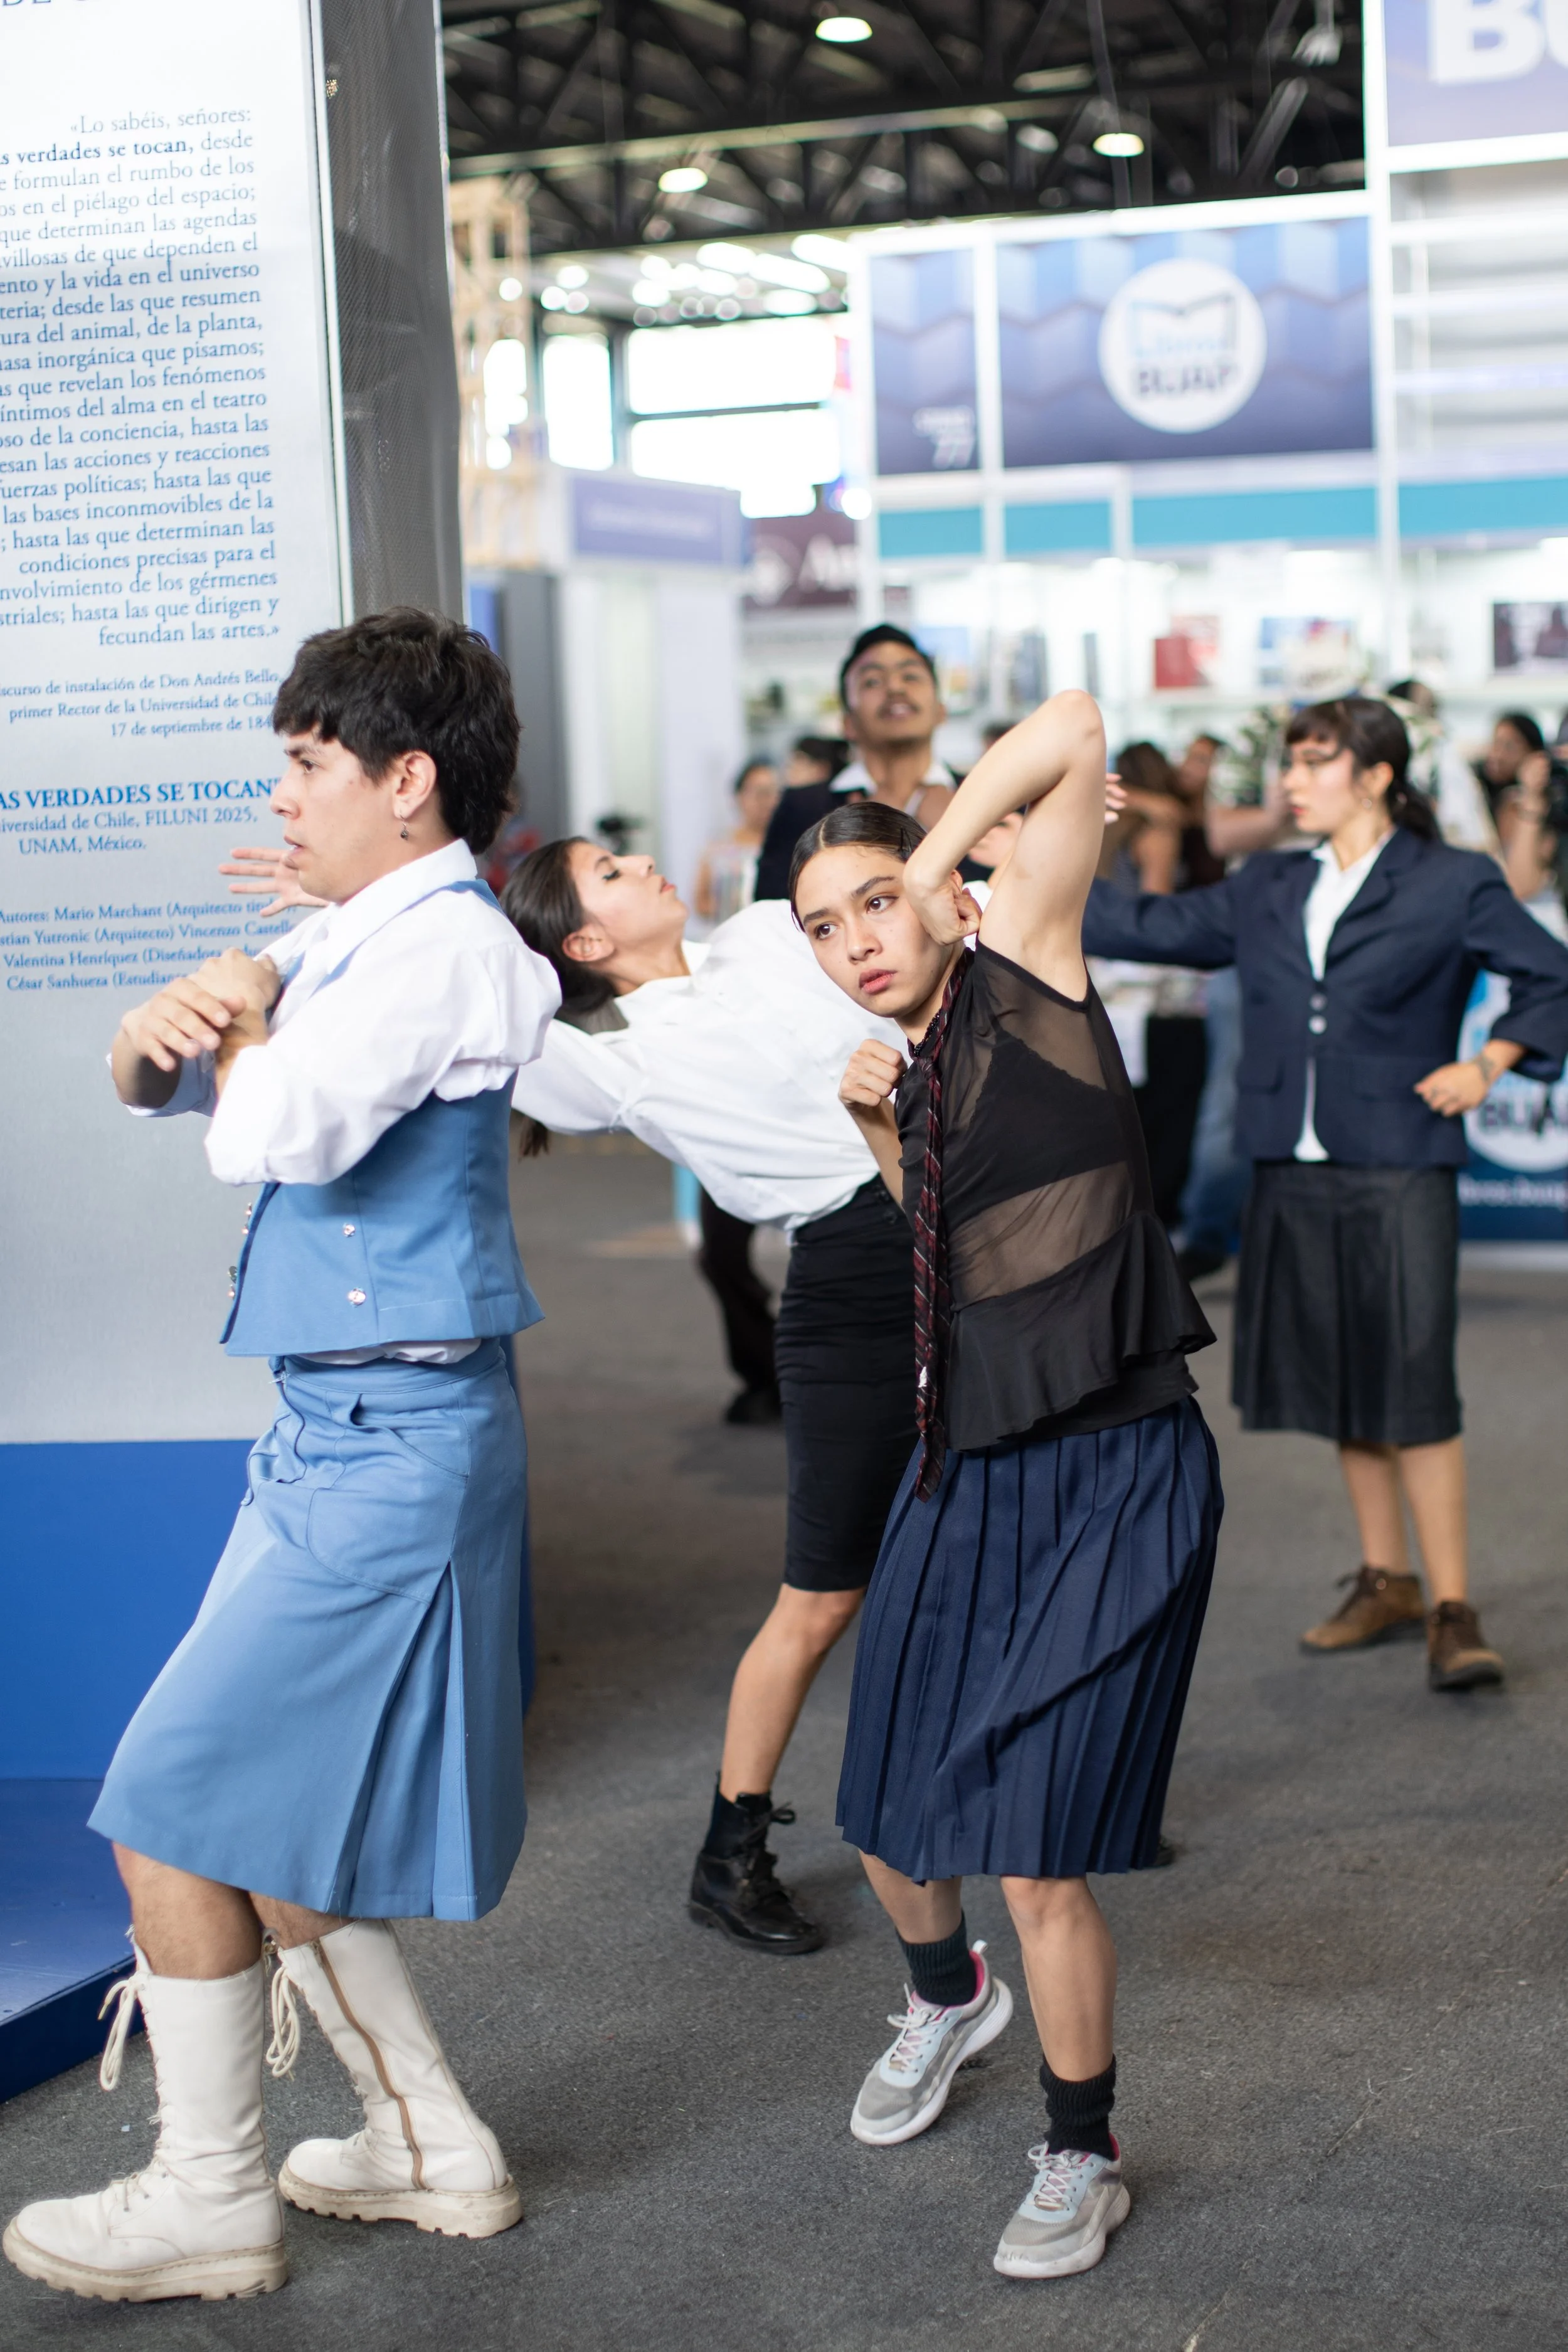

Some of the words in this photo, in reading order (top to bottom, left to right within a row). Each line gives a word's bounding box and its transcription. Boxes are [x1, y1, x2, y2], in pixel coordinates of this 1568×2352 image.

[112, 111, 170, 131] sabéis,
[177, 108, 250, 126] señores:
[17, 141, 100, 163] verdades
[109, 146, 125, 157] se
[134, 141, 193, 155] tocan,
[201, 129, 253, 151] desde
[14, 167, 100, 190] formulan
[107, 164, 122, 183] el
[130, 160, 193, 181] rumbo
[200, 157, 221, 176] de
[229, 155, 254, 174] los
[23, 203, 44, 215] en
[51, 193, 66, 213] el
[74, 191, 139, 218] piélago
[147, 186, 174, 206] del
[181, 183, 255, 210] espacio;
[0, 229, 31, 248] que
[38, 220, 145, 240] determinan
[153, 213, 176, 231] las
[183, 209, 257, 236] agendas
[0, 247, 68, 268] villosas
[75, 244, 95, 263] de
[103, 248, 136, 268] que
[143, 235, 236, 268] dependen
[243, 231, 258, 252] el
[44, 278, 55, 297] y
[61, 270, 77, 290] la
[83, 264, 122, 288] vida
[129, 272, 151, 285] en
[157, 263, 172, 283] el
[180, 263, 260, 282] universo
[52, 294, 104, 316] desde
[110, 292, 134, 312] las
[140, 297, 174, 317] que
[182, 290, 261, 307] resumen
[37, 322, 64, 343] del
[72, 317, 140, 341] animal,
[147, 315, 169, 336] de
[176, 314, 191, 334] la
[198, 312, 262, 339] planta,
[0, 358, 31, 371] asa
[38, 347, 135, 374] inorgánica
[142, 348, 176, 371] que
[183, 341, 263, 366] pisamos;
[18, 382, 51, 401] que
[59, 372, 124, 393] revelan
[130, 369, 156, 388] los
[162, 366, 266, 386] fenómenos
[0, 404, 70, 423] íntimos
[77, 396, 104, 417] del
[111, 395, 156, 415] alma
[162, 399, 184, 411] en
[191, 389, 206, 410] el
[213, 394, 267, 408] teatro
[30, 426, 51, 446] de
[58, 425, 73, 444] la
[80, 423, 184, 443] conciencia,
[191, 416, 238, 435] hasta
[245, 413, 268, 432] las
[44, 451, 68, 470] las
[74, 450, 151, 469] acciones
[156, 451, 169, 471] y
[175, 442, 270, 462] reacciones
[0, 479, 57, 499] uerzas
[64, 474, 146, 502] políticas;
[153, 470, 201, 490] hasta
[207, 467, 231, 486] las
[237, 470, 272, 490] que
[3, 505, 26, 524] las
[33, 503, 80, 522] bases
[87, 493, 223, 519] inconmovibles
[229, 490, 251, 511] de
[257, 489, 273, 509] la
[13, 530, 60, 549] hasta
[66, 526, 89, 546] las
[96, 531, 130, 551] que
[136, 521, 244, 542] determinan
[250, 515, 274, 535] las
[19, 552, 130, 574] condiciones
[135, 548, 208, 576] precisas
[215, 549, 254, 567] para
[260, 539, 275, 560] el
[129, 572, 151, 593] de
[157, 571, 183, 591] los
[189, 571, 277, 596] gérmenes
[72, 603, 119, 622] hasta
[125, 599, 149, 619] las
[155, 603, 189, 623] que
[195, 595, 261, 620] dirigen
[267, 598, 279, 617] y
[99, 625, 184, 645] fecundan
[191, 621, 215, 640] las
[45, 681, 60, 694] de
[65, 677, 135, 693] instalación
[139, 675, 154, 689] de
[159, 674, 189, 688] Don
[194, 671, 240, 686] Andrés
[9, 706, 53, 724] primer
[58, 702, 100, 716] Rector
[104, 700, 120, 714] de
[124, 699, 135, 713] la
[140, 694, 220, 711] Universidad
[223, 694, 239, 708] de
[112, 723, 127, 737] 17
[130, 721, 146, 736] de
[151, 718, 222, 738] septiembre
[226, 716, 242, 731] de
[25, 785, 151, 808] VERDADES
[157, 784, 184, 802] SE
[0, 814, 66, 832] iversidad
[72, 813, 89, 830] de
[94, 811, 139, 828] Chile,
[146, 807, 207, 826] FILUNI
[214, 806, 258, 823] 2025,
[19, 837, 82, 854] UNAM,
[87, 835, 146, 851] México.
[55, 907, 94, 921] Mario
[3, 953, 65, 968] Valentina
